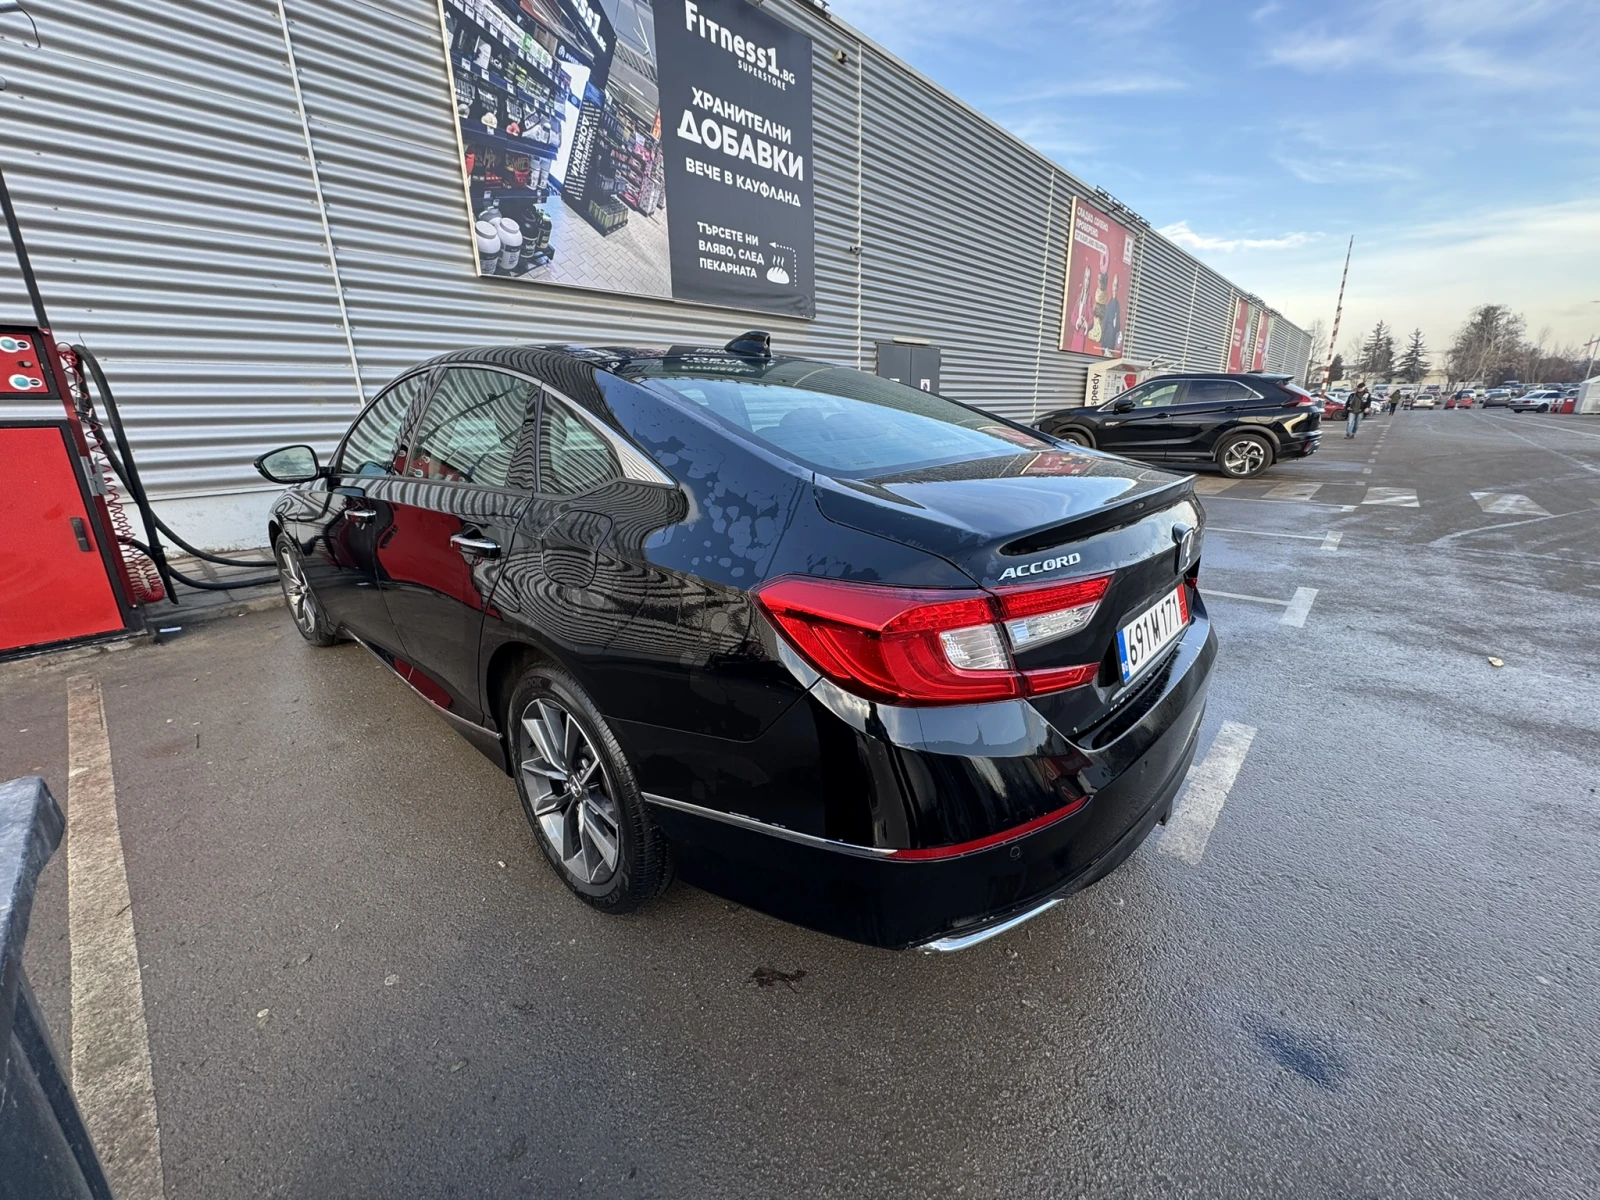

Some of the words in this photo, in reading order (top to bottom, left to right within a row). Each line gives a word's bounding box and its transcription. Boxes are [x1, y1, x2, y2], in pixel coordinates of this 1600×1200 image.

[737, 59, 786, 91] SUPERSTORE
[692, 86, 792, 145] ХРАНИТЕЛНИ
[570, 114, 590, 177] ДОБАВКИ
[677, 109, 803, 181] ДОБАВКИ
[685, 157, 721, 181] ВЕЧЕ
[724, 170, 733, 185] В
[736, 174, 801, 207] КАУФЛАНД
[697, 221, 743, 243] ТЪРСЕТЕ
[745, 233, 759, 246] НИ
[698, 239, 736, 259] ВЛЯВО,
[738, 249, 765, 265] СЛЕД
[699, 257, 758, 279] ПЕКАРНАТА
[1091, 373, 1102, 406] speedy
[998, 552, 1081, 581] ACCORD
